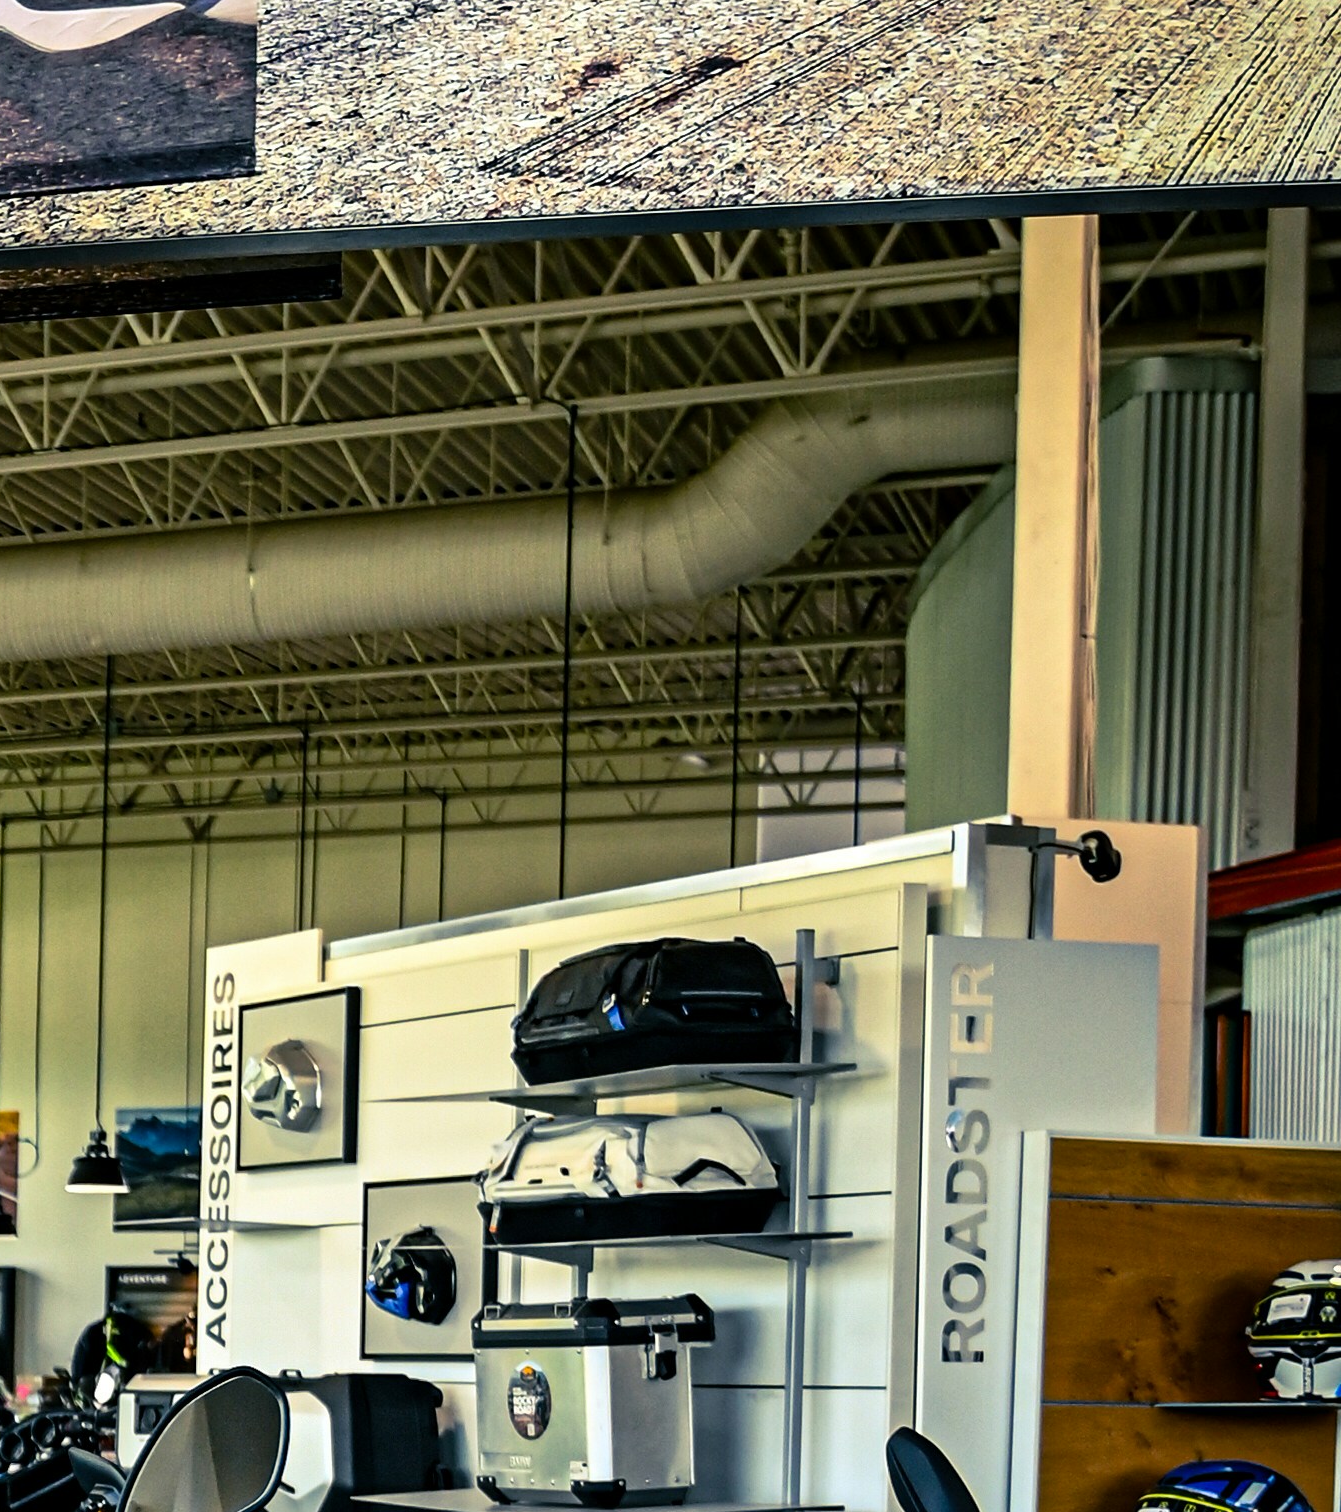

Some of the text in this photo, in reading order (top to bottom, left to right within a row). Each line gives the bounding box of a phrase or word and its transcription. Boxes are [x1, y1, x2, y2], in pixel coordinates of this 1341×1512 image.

[205, 971, 236, 1348] ACCESSOIRES
[942, 962, 994, 1363] ROADSTER
[118, 1273, 167, 1284] ADVENTURE
[509, 1455, 531, 1468] BMW
